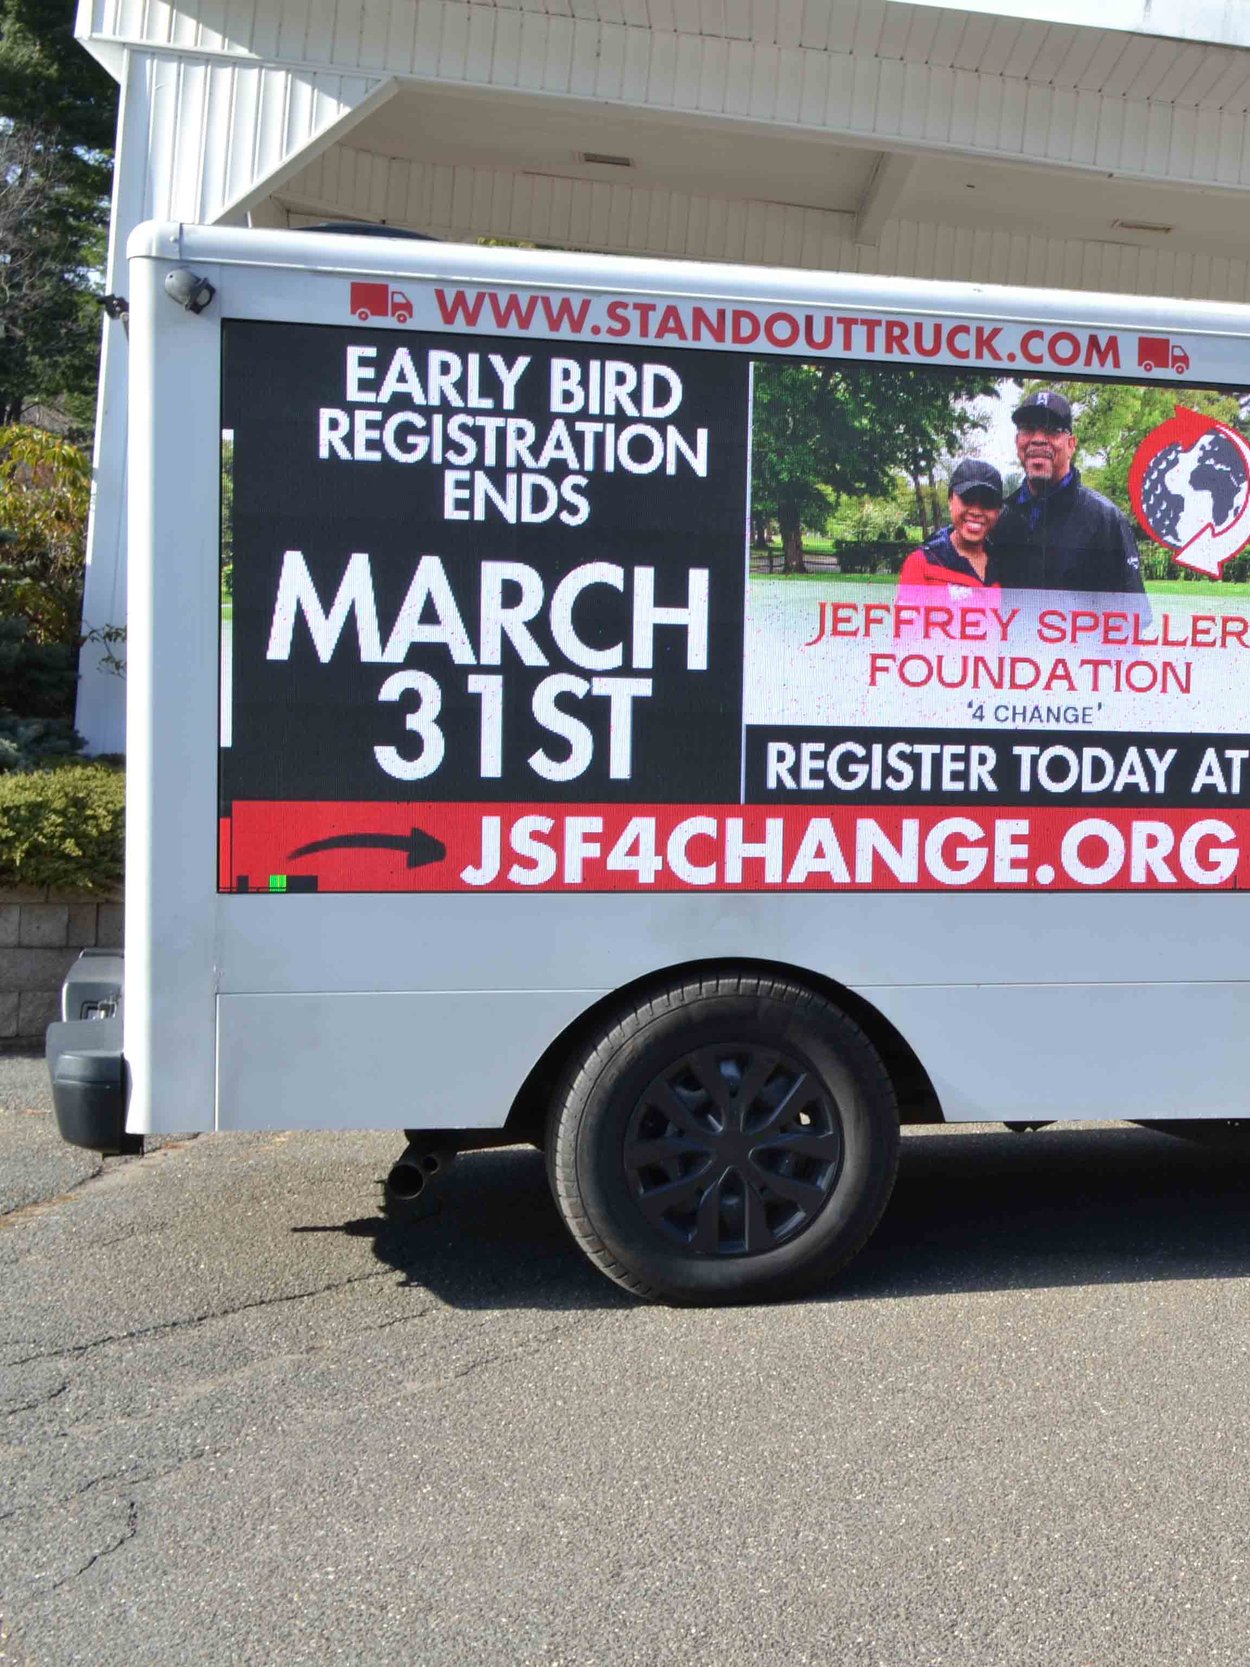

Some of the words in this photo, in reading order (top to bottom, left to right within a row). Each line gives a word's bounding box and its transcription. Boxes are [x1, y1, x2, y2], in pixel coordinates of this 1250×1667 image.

[434, 289, 1121, 369] WWW.STANDOUTTRUCK.COM
[345, 346, 531, 410] EARLY
[549, 357, 683, 419] BIRD
[317, 407, 709, 478] REGISTRATION
[443, 469, 591, 527] ENDS
[265, 549, 710, 671] MARCH
[804, 601, 1022, 646] JEFFREY
[1036, 608, 1250, 649] SPELLER
[867, 652, 1194, 694] FOUNDATION
[373, 668, 653, 783] 31ST
[766, 741, 1000, 792] REGISTER
[1012, 745, 1178, 794] TODAY
[1191, 749, 1250, 794] AT
[459, 813, 1240, 887] JSF4CHANGE.ORG
